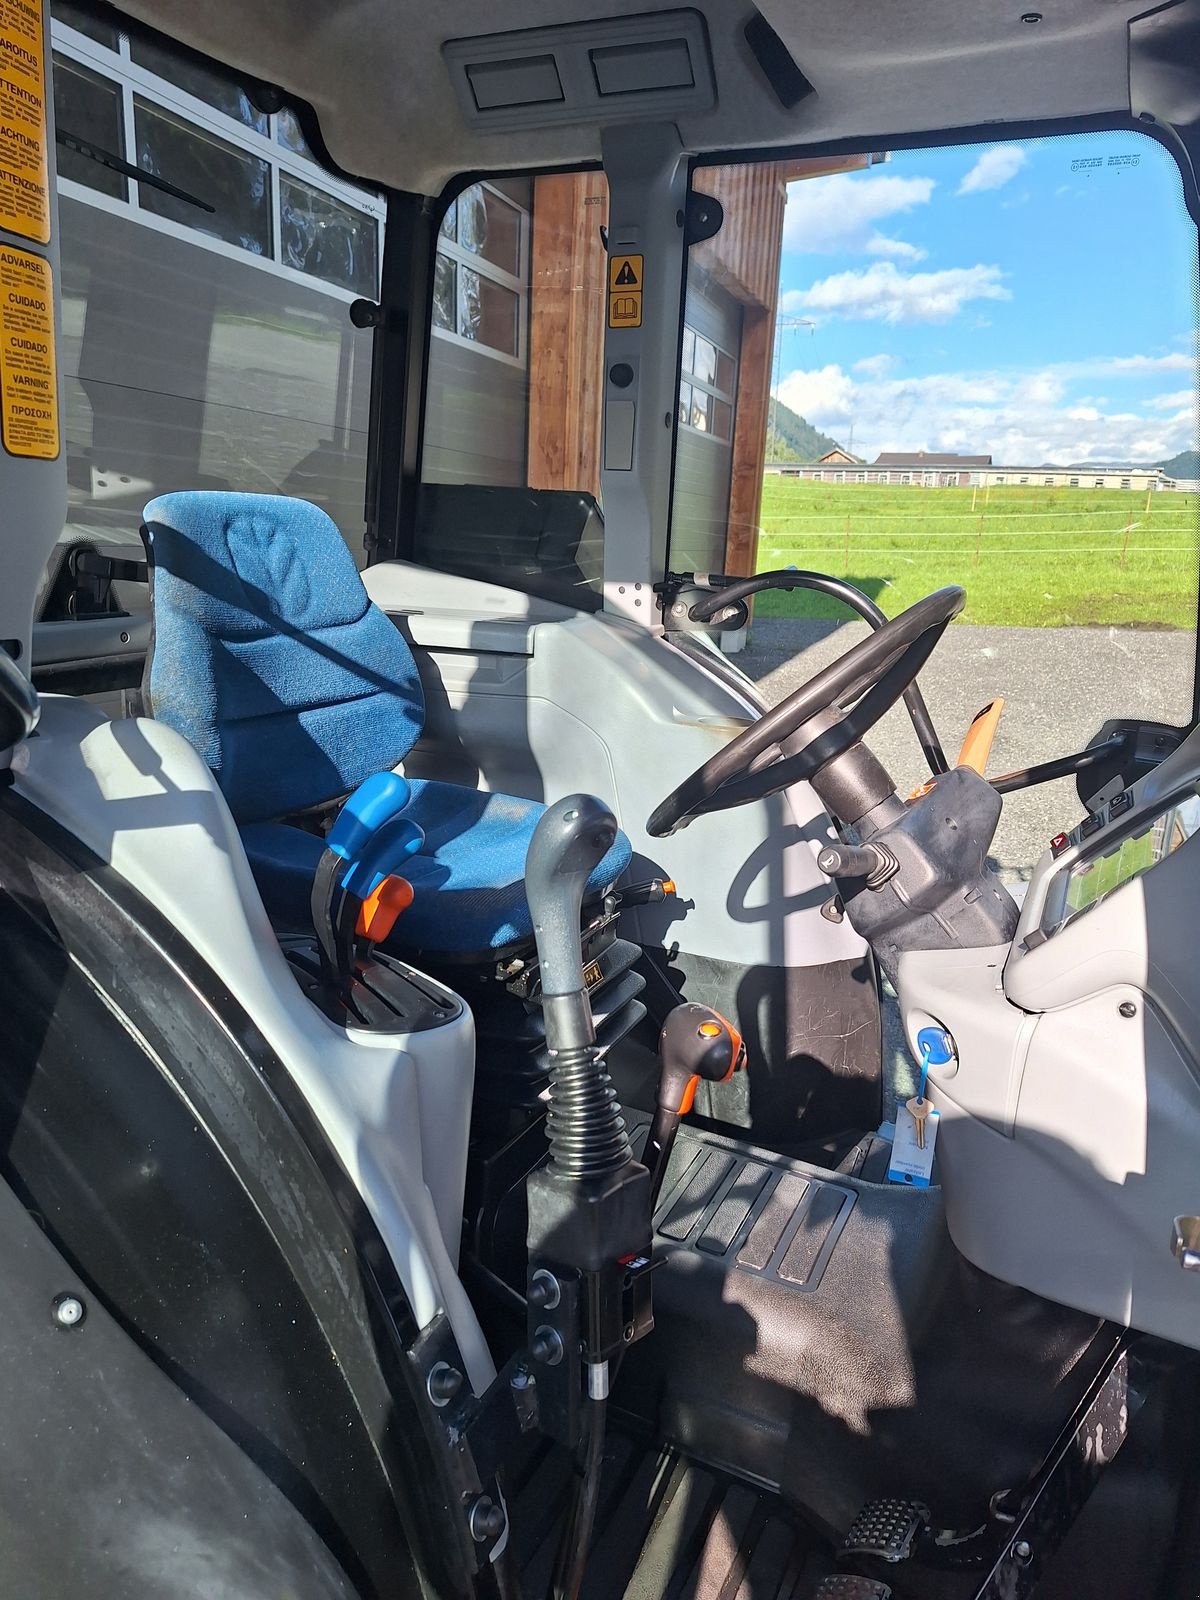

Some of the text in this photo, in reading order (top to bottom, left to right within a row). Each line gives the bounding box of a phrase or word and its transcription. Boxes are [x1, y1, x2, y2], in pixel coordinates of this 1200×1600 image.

[0, 38, 38, 67] AROITUS
[0, 78, 42, 108] TTENTION
[1, 126, 40, 152] ACHTUNG
[1, 253, 45, 275] ADVARSEL
[8, 293, 46, 311] CUIDADO
[10, 337, 48, 354] CUIDADO
[12, 374, 49, 390] VARNING
[11, 405, 52, 420] ΠΡΟΣΟΧΗ
